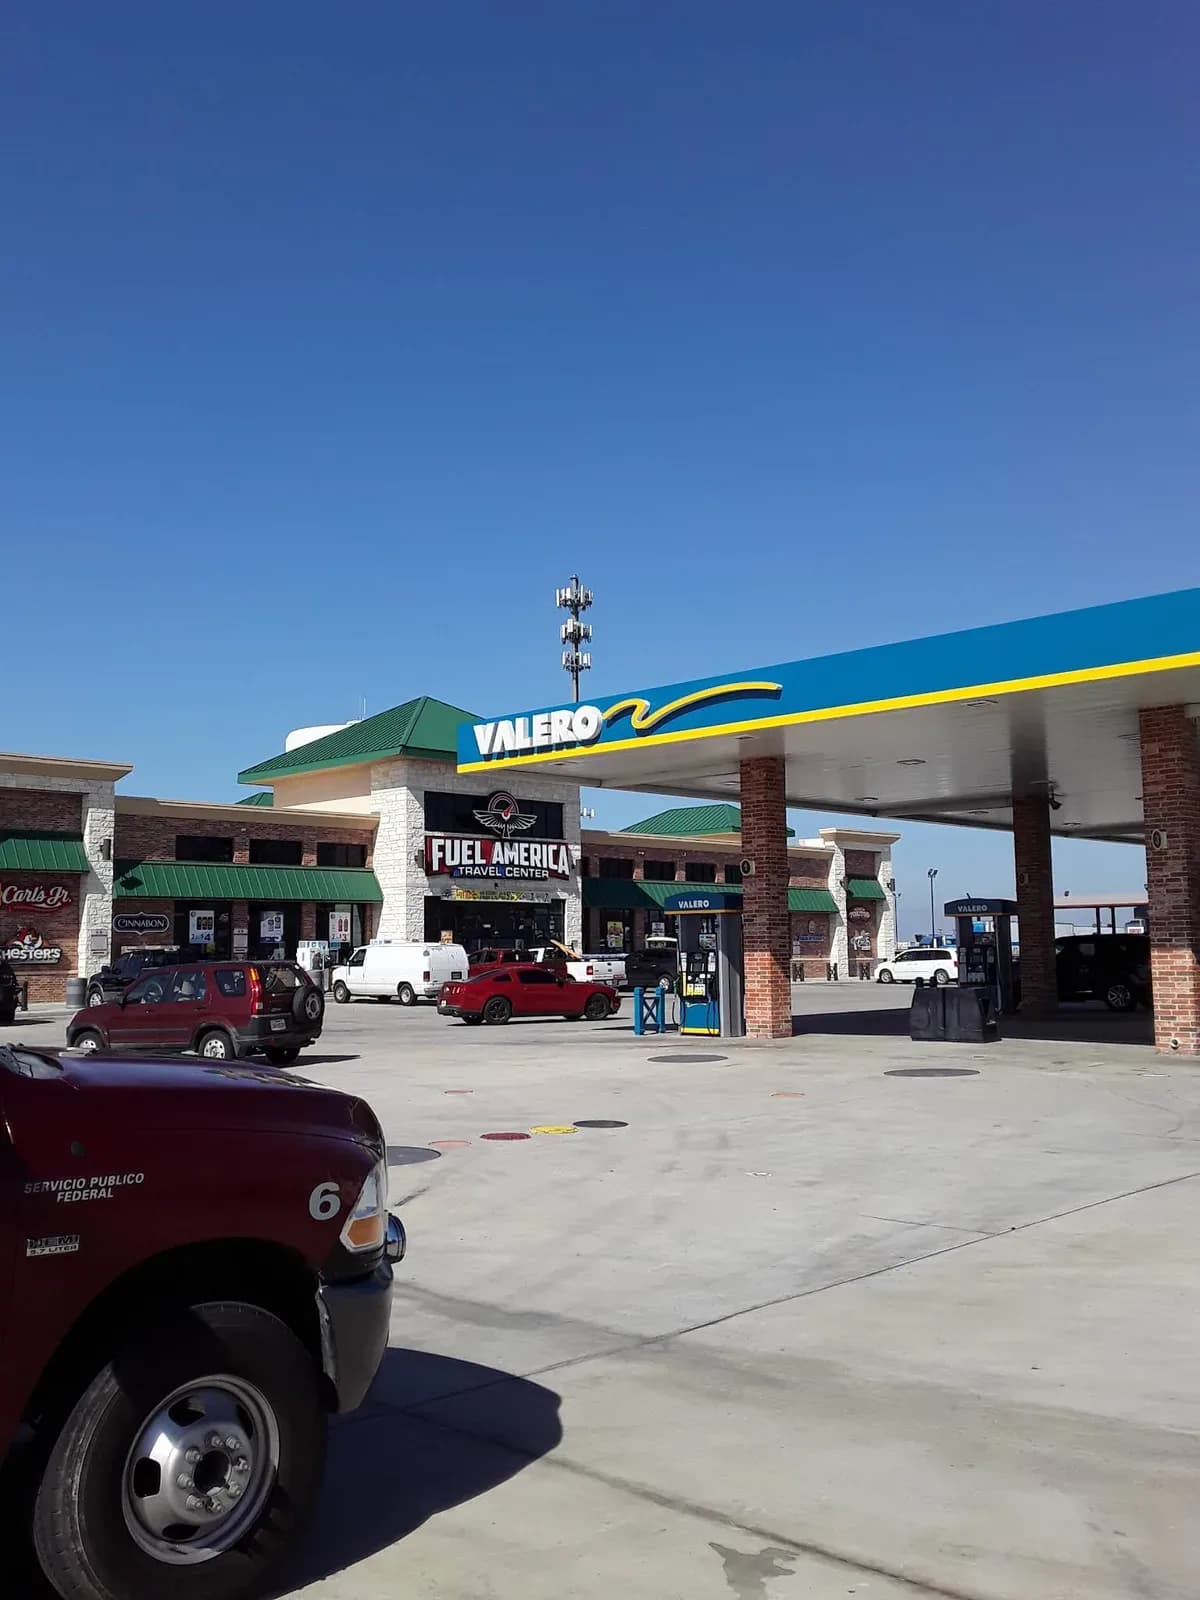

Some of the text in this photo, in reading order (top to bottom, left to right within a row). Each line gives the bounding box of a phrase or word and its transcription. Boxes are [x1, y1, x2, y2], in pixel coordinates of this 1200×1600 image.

[473, 705, 602, 755] VALERO
[431, 838, 570, 876] FUEL AMERICA
[458, 866, 550, 878] TRAVEL CENTER
[2, 885, 72, 905] Carl's Jr.
[678, 899, 710, 909] VALERO
[957, 904, 988, 912] VALERO
[117, 919, 165, 928] CINNABON
[24, 1173, 145, 1194] SERVICIO PUBLICO
[57, 1187, 114, 1203] FEDERAL
[309, 1181, 341, 1221] 6
